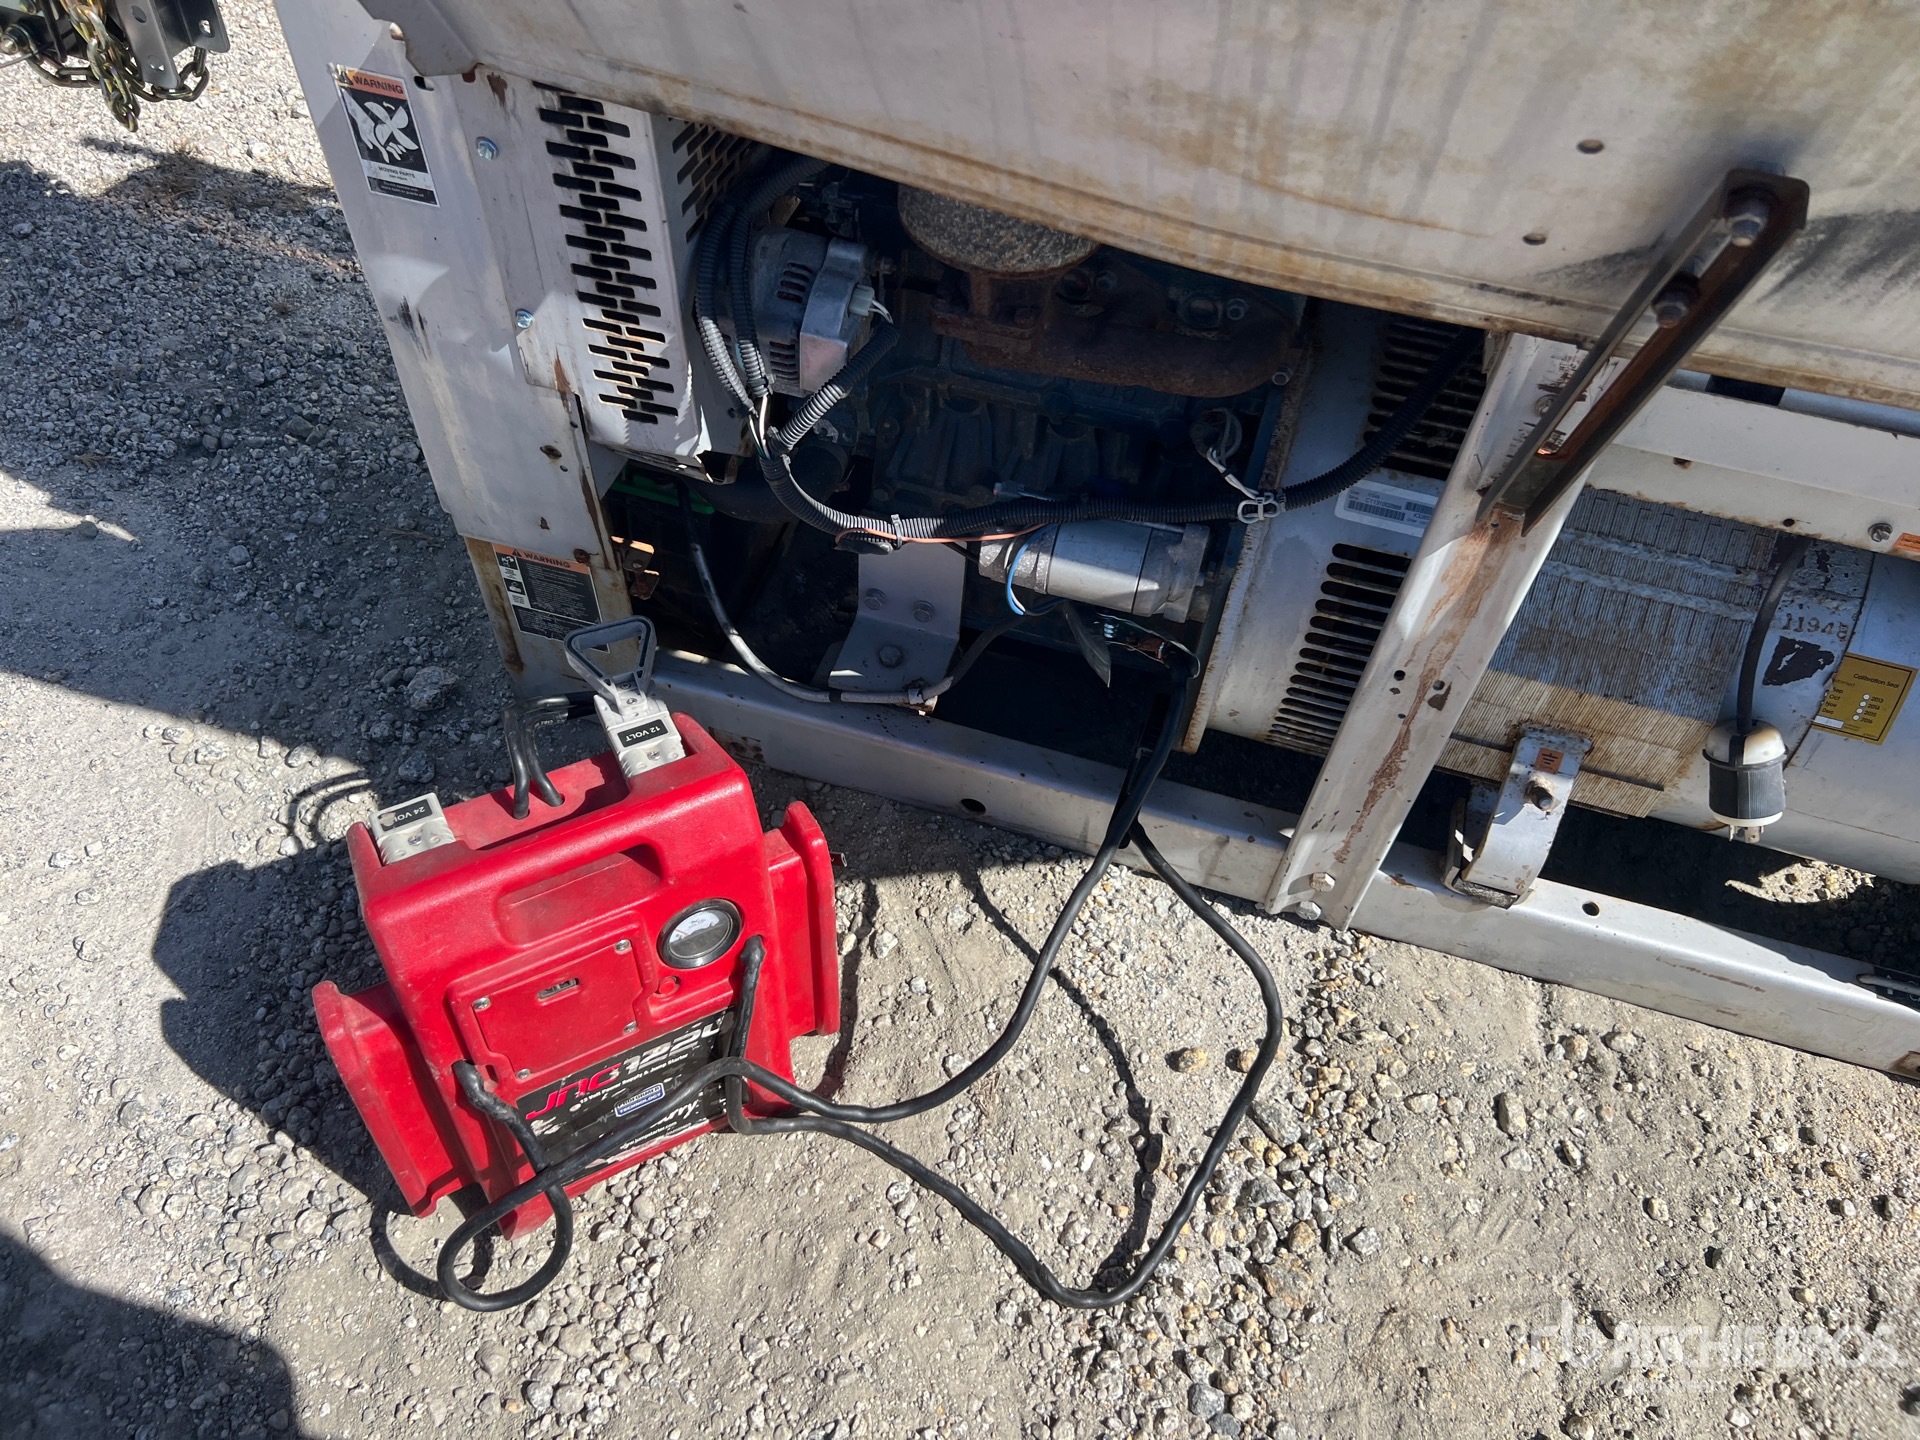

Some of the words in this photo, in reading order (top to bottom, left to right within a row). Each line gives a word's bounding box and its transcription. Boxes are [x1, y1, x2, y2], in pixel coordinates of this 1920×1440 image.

[353, 76, 404, 94] WARNING
[523, 552, 571, 568] WARNING
[1853, 673, 1886, 685] Calibration
[1886, 680, 1900, 689] Seal
[1821, 707, 1834, 715] Dec
[625, 729, 650, 742] VOLT
[650, 726, 661, 734] 12
[413, 806, 425, 815] 24
[589, 1090, 601, 1100] Volt
[602, 1083, 621, 1094] Power
[622, 1073, 643, 1085] Supply
[650, 1063, 667, 1073] Jump
[667, 1053, 689, 1065] Starter
